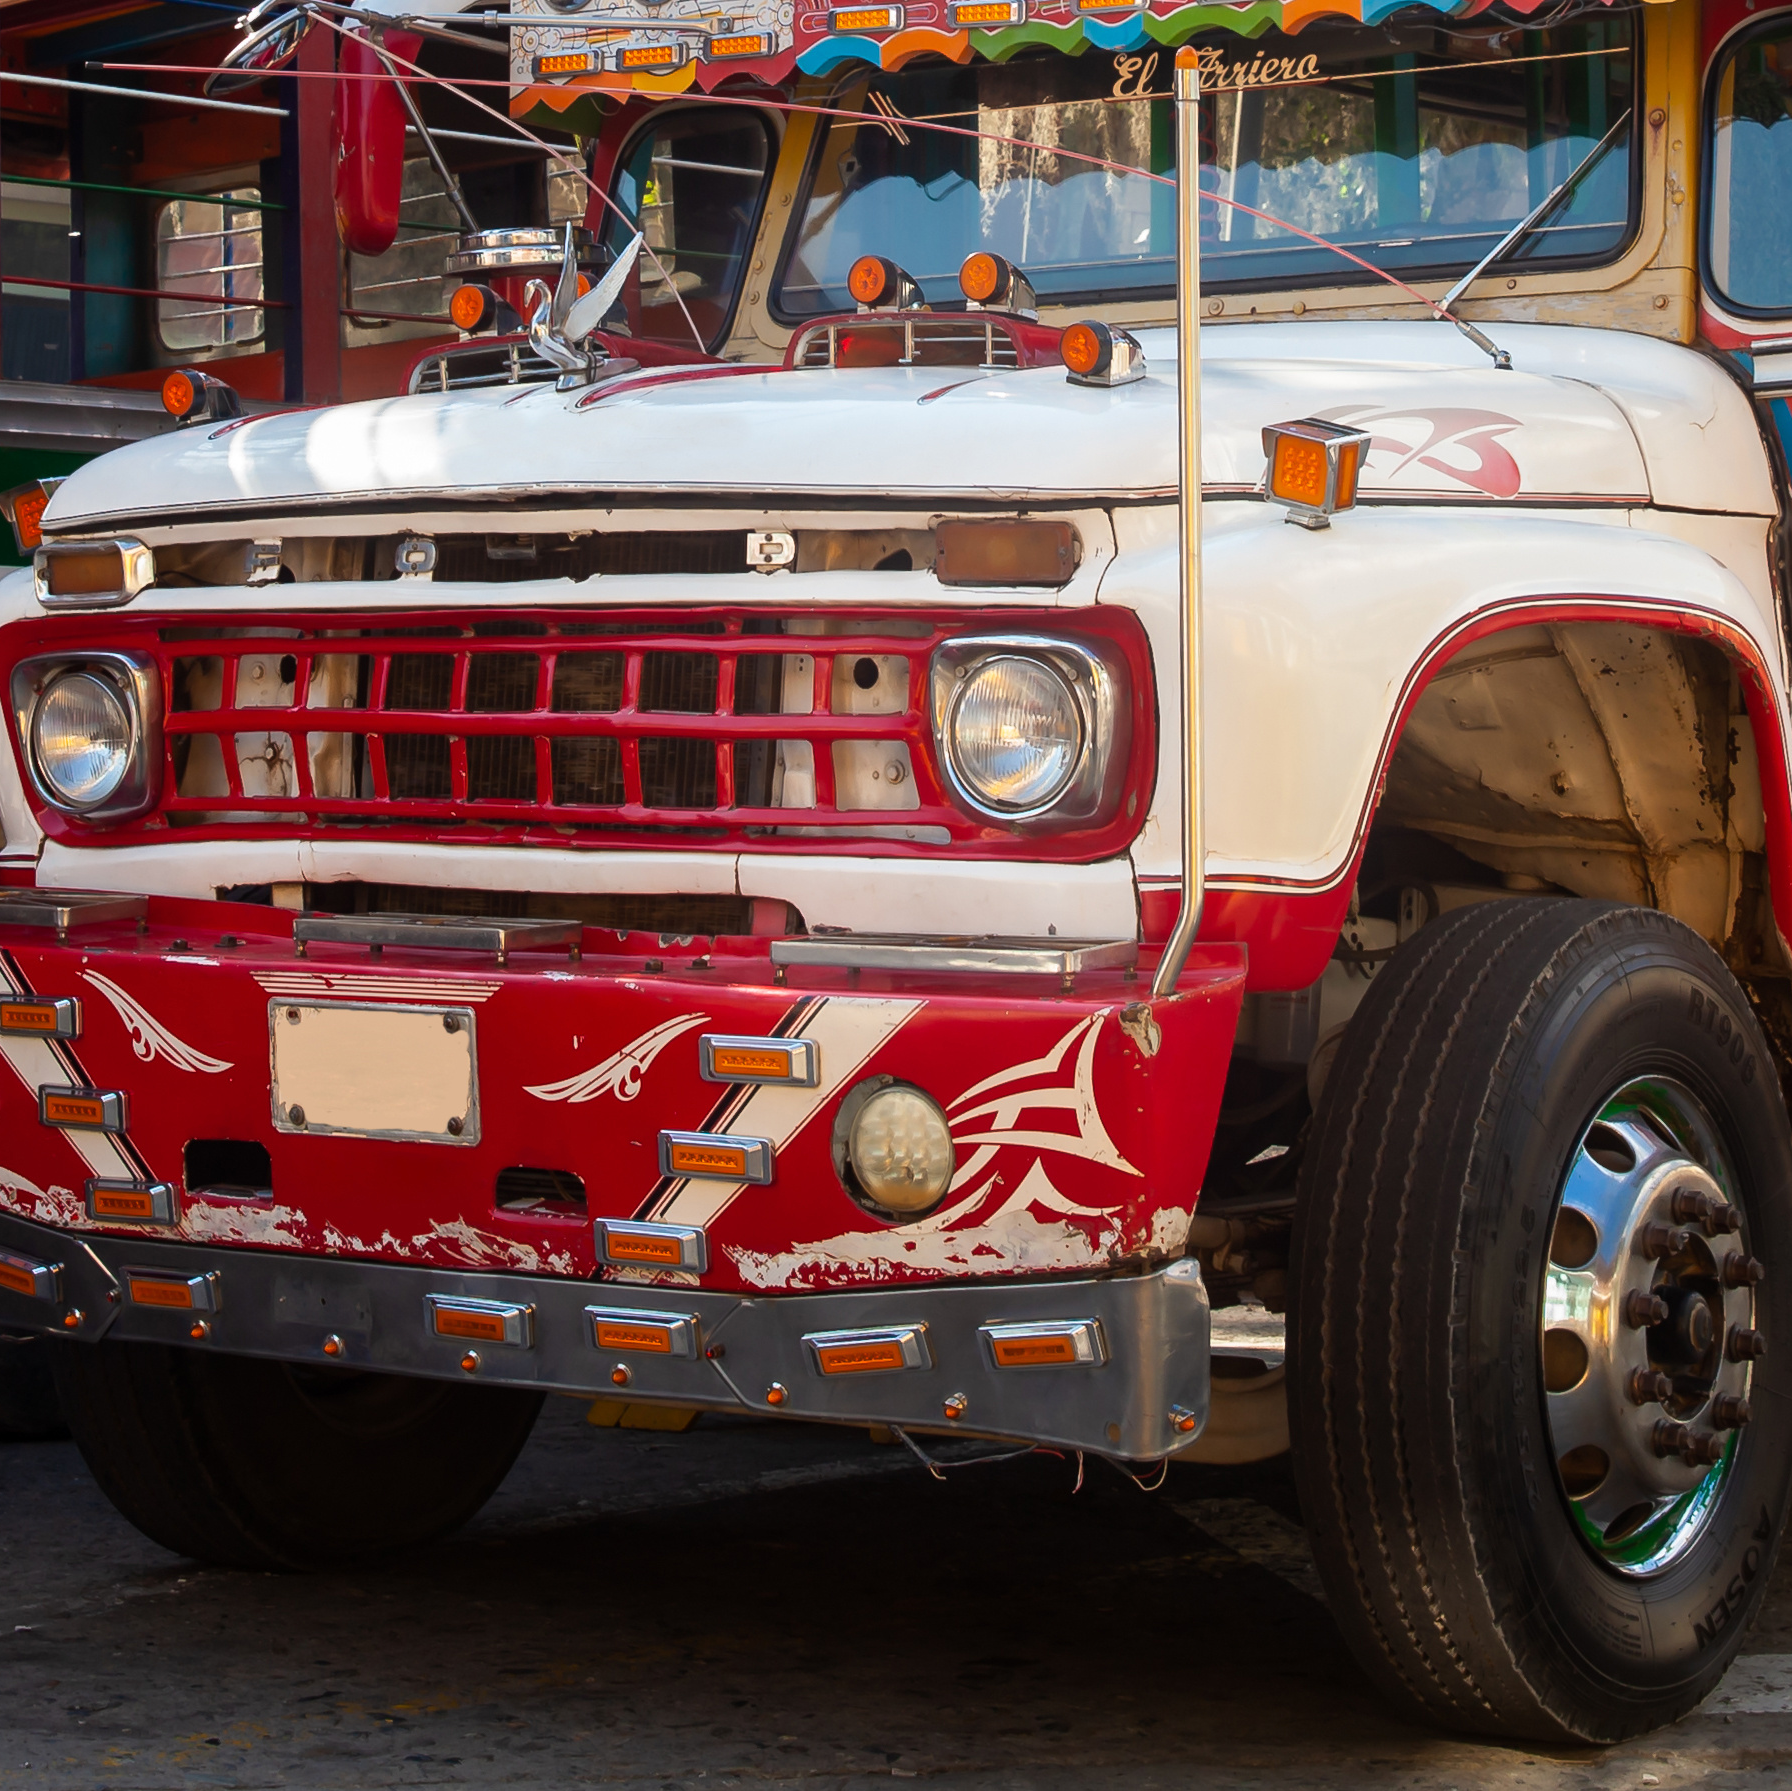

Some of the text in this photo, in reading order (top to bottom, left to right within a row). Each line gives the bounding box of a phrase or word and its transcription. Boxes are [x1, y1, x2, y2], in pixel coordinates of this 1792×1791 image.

[1112, 46, 1320, 98] El Arriero
[1687, 985, 1758, 1087] RT906
[1693, 1501, 1772, 1653] AOSEN
